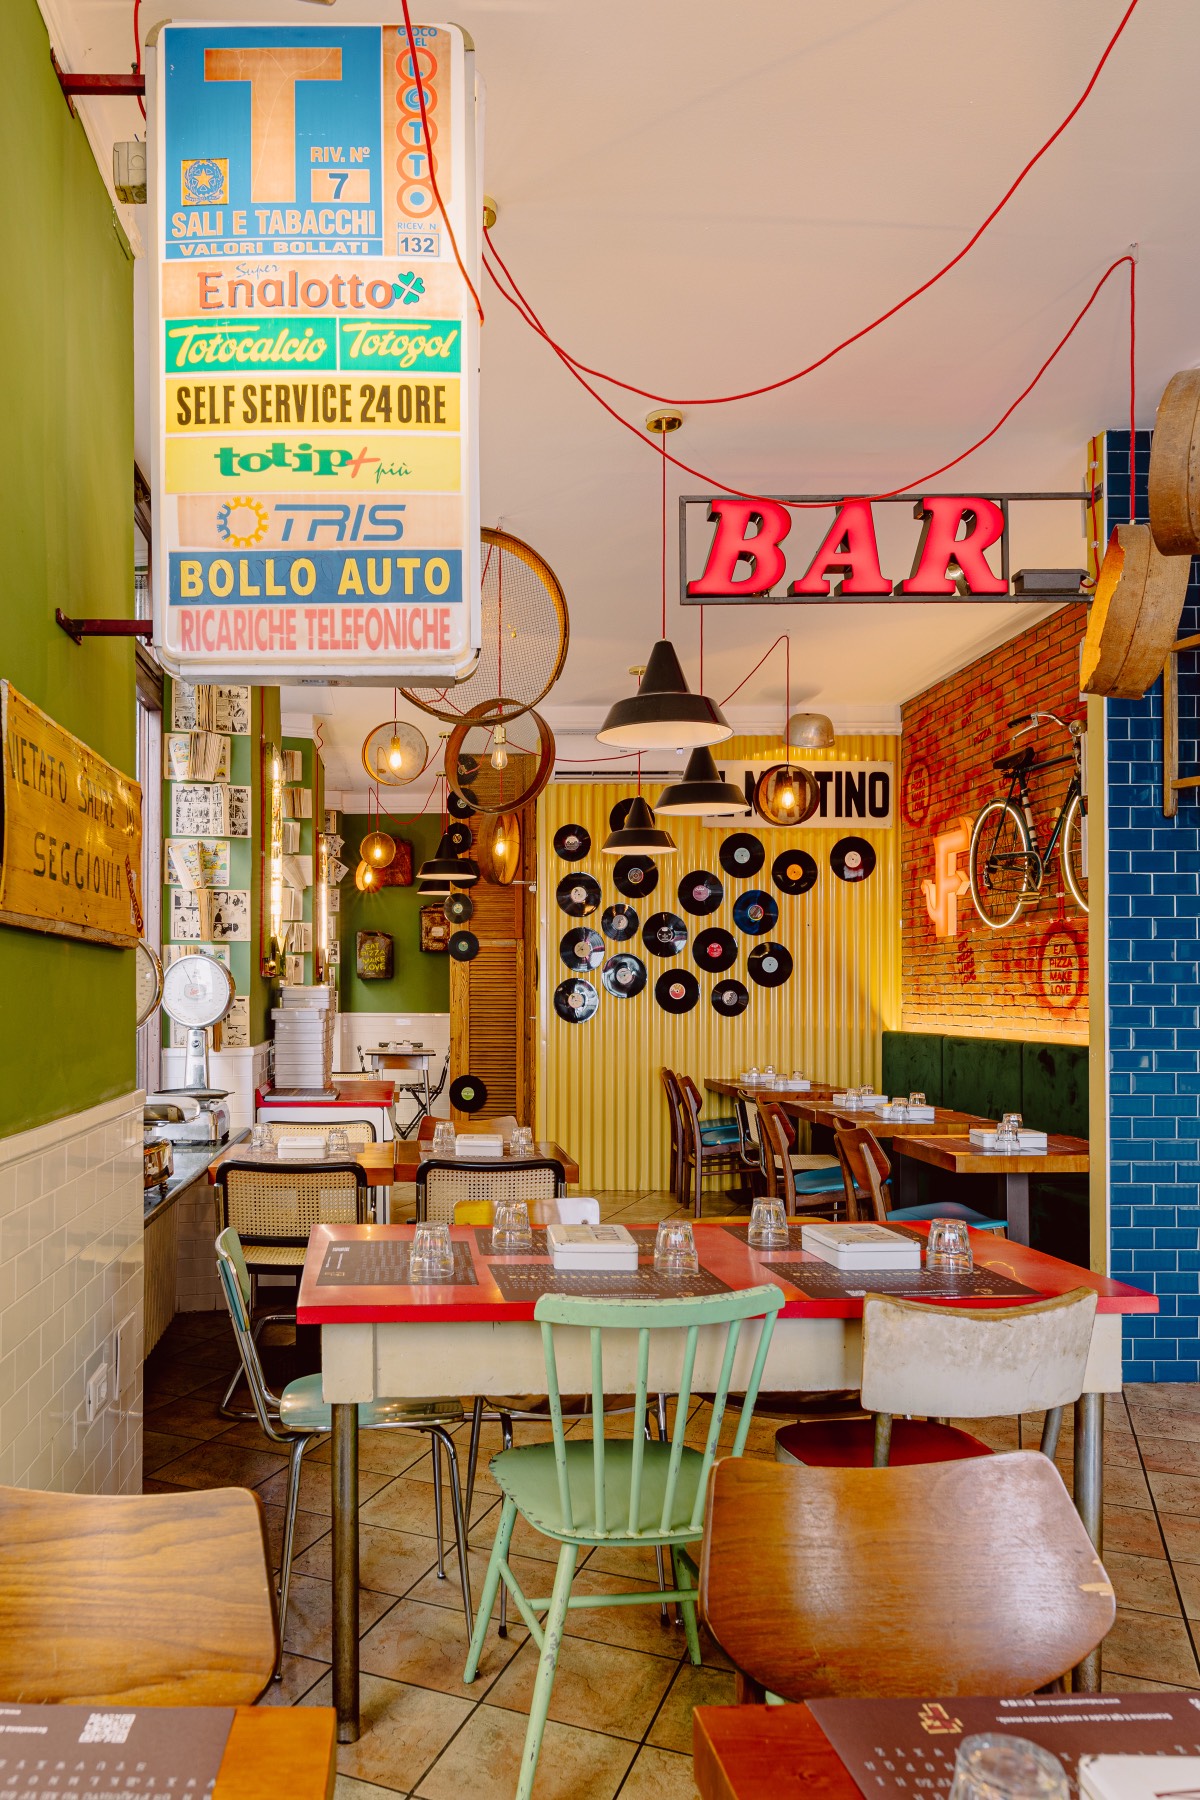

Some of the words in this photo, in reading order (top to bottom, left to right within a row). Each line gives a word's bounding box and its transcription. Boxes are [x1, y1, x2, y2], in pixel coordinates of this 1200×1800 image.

[398, 26, 438, 37] GOCO
[204, 48, 342, 203] T
[310, 147, 345, 162] RIV.
[328, 173, 349, 200] 7
[171, 211, 223, 238] SALI
[233, 211, 247, 235] E
[255, 209, 375, 235] TABACCHI
[179, 243, 263, 256] VALORI
[274, 241, 369, 254] BOLLATI
[400, 237, 434, 253] 132
[235, 263, 280, 279] Super
[197, 270, 397, 310] Enalotto
[168, 324, 328, 367] Totocalcio
[342, 322, 458, 368] Totogol
[176, 385, 235, 425] SELF
[242, 384, 352, 424] SERVICE
[360, 385, 392, 423] 24
[398, 385, 446, 424] ORE
[274, 504, 406, 542] TRIS
[687, 496, 1009, 597] BAR
[179, 557, 317, 598] BOLLO
[337, 557, 451, 596] AUTO
[181, 608, 297, 652] RICARICHE
[304, 607, 451, 651] TELEFONICHE
[974, 728, 992, 746] PIZZA
[7, 731, 68, 803] VIETATO
[34, 831, 122, 901] SEGGIOVIA
[362, 956, 386, 964] MAKE
[1053, 944, 1068, 955] EAT
[364, 963, 386, 972] LOVE
[1050, 958, 1073, 969] PIZZA
[1050, 971, 1073, 981] MAKE
[1051, 985, 1072, 995] LOVE
